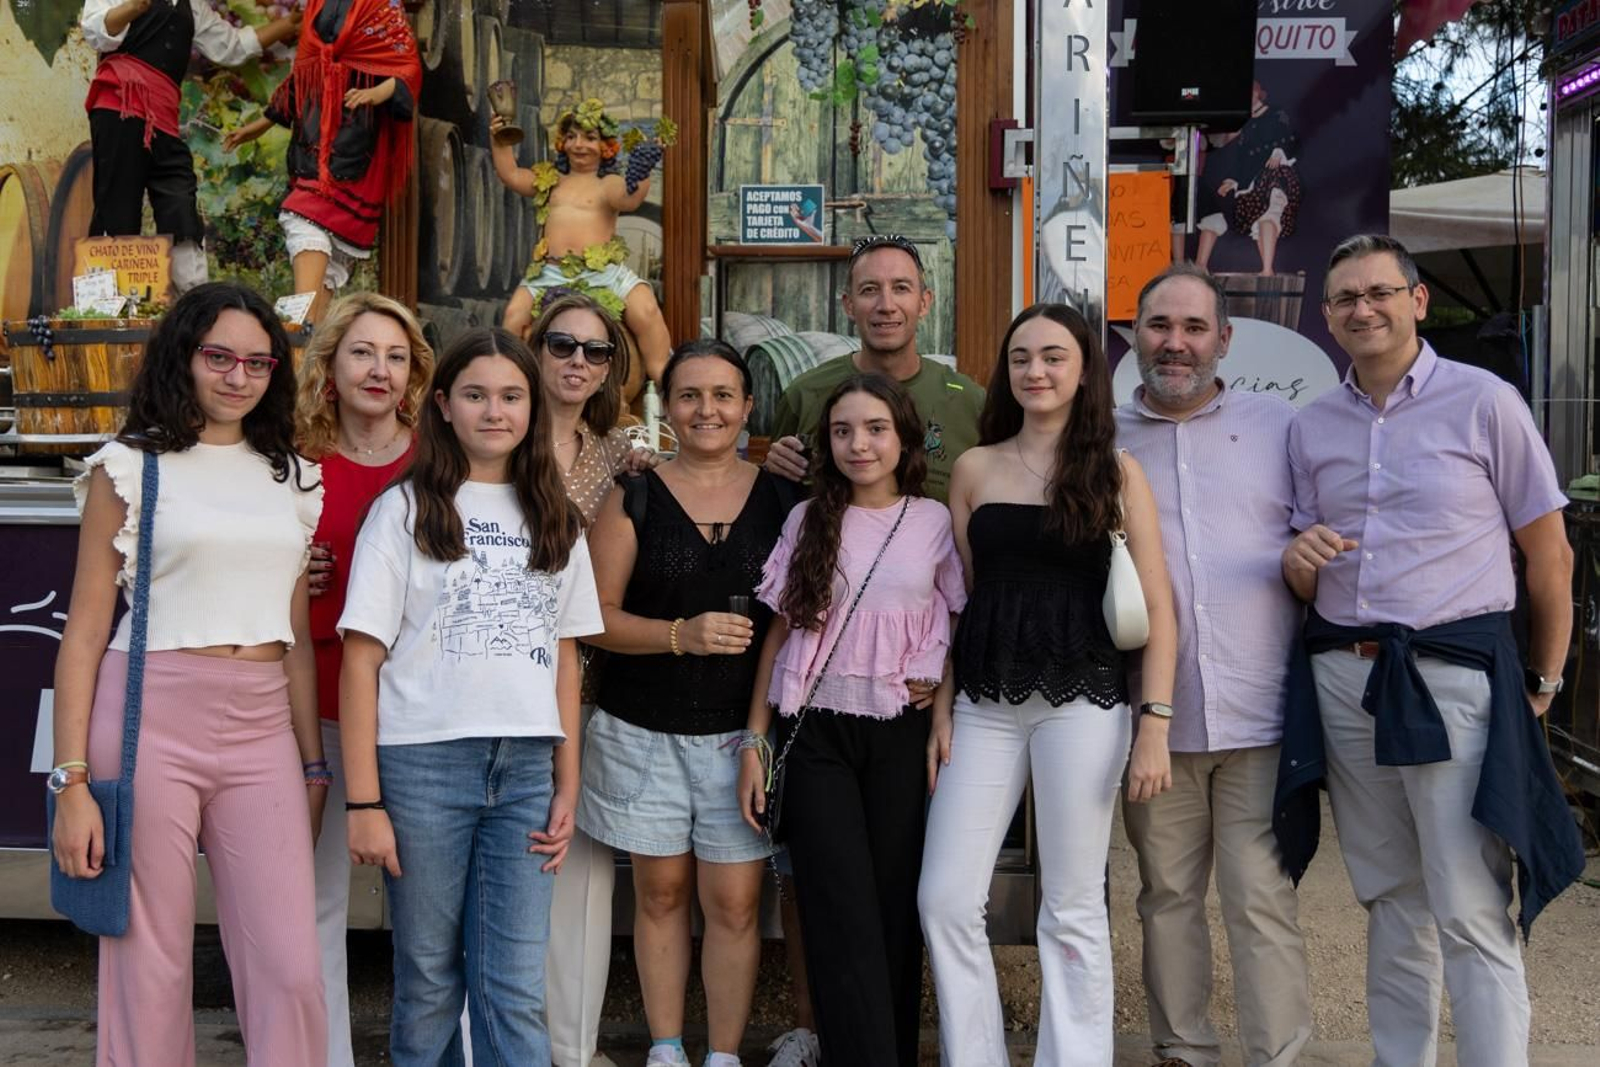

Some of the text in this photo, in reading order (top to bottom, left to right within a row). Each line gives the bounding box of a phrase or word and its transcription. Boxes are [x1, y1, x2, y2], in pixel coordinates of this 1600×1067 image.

[1257, 24, 1336, 55] QUITO
[1062, 0, 1091, 319] RIÑEN
[746, 191, 802, 202] ACEPTAMOS
[746, 203, 772, 215] PAGO
[746, 215, 784, 227] TARJETA
[746, 226, 800, 239] DE CRÉDITO
[89, 243, 160, 257] CHATO DE VINO
[128, 271, 159, 284] TRIPLE
[465, 518, 500, 533] San
